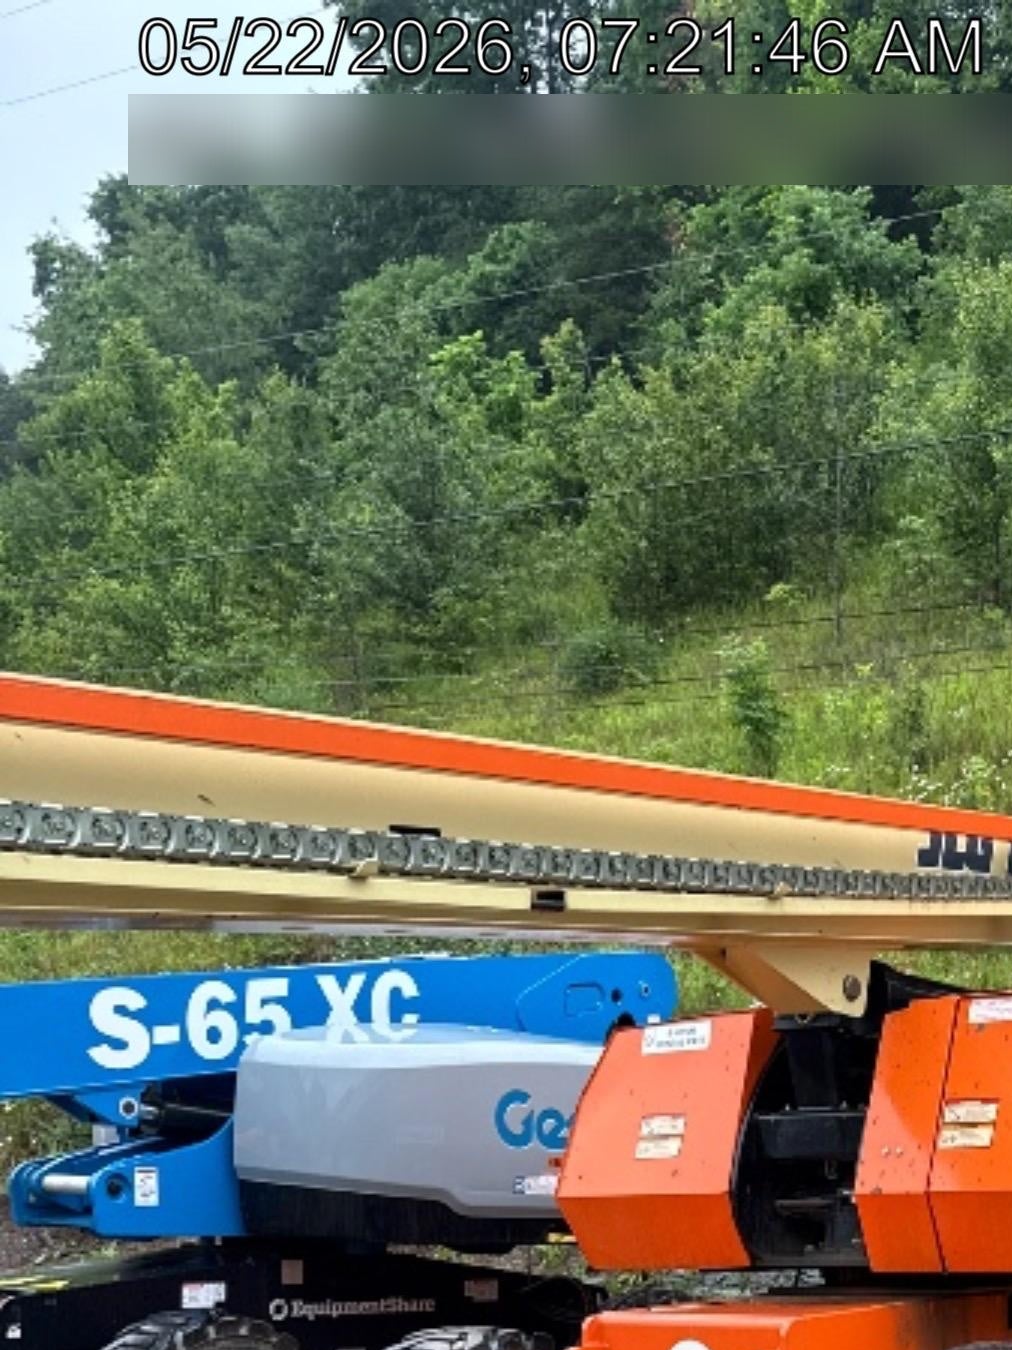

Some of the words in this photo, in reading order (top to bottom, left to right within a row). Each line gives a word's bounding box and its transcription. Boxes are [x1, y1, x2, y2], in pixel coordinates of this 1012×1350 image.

[86, 977, 292, 1069] S-65
[315, 969, 420, 1043] XC
[290, 1297, 436, 1321] EquipmentShare
